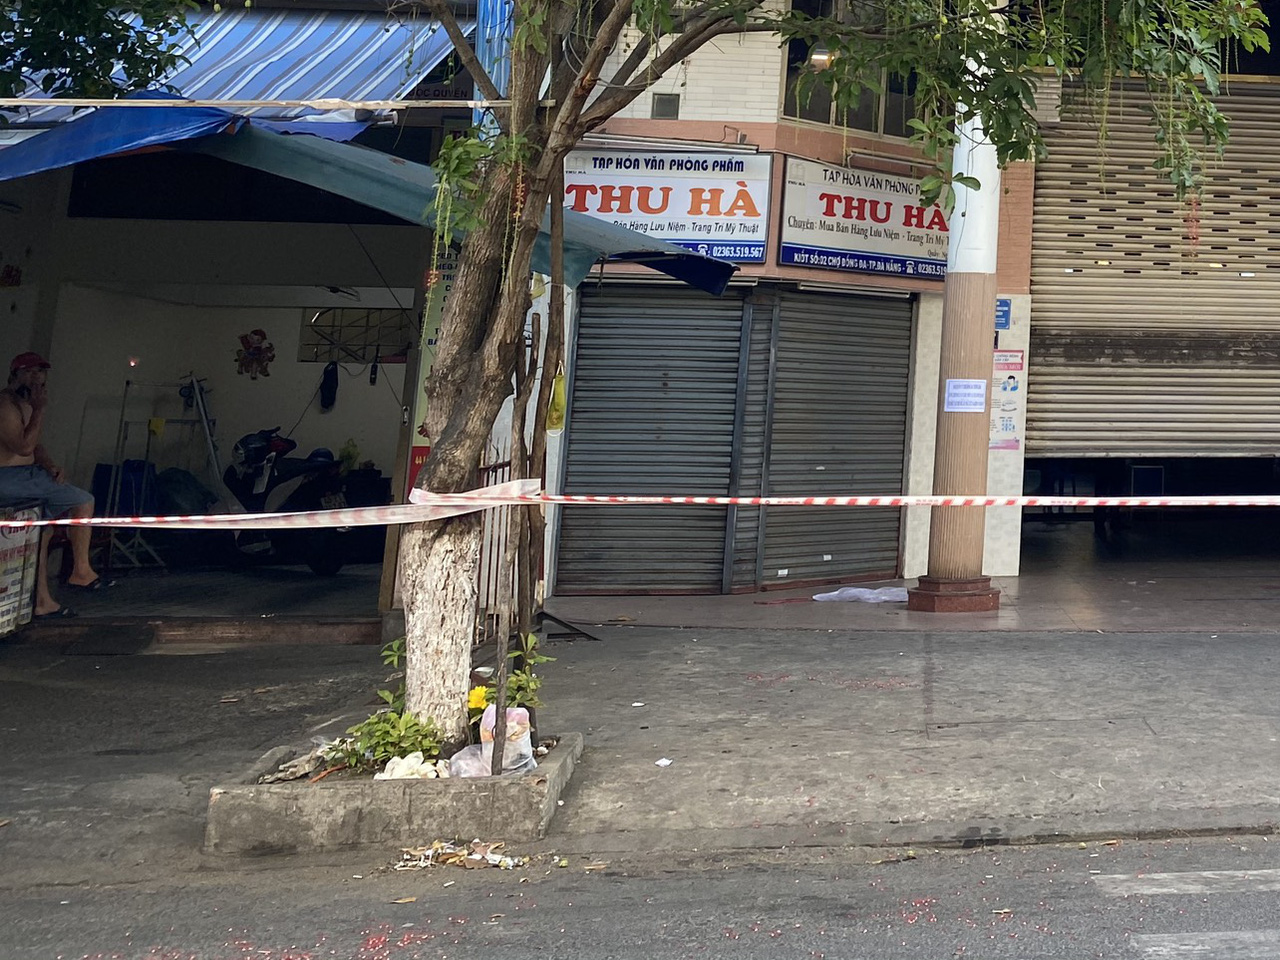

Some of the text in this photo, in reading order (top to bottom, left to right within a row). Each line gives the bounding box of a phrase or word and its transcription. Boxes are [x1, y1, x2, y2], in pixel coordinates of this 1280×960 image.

[592, 156, 613, 171] TẠP
[615, 154, 640, 170] HÓA
[644, 155, 665, 171] VĂN
[669, 158, 708, 172] PHÒNG
[823, 168, 841, 185] TẠP
[864, 173, 883, 190] VĂN
[565, 180, 761, 217] THU HÀ
[819, 192, 949, 232] THU HÀ
[629, 220, 648, 233] Hàng
[650, 221, 665, 231] Lưu
[667, 222, 686, 233] Niệm
[691, 222, 712, 234] Trang
[738, 223, 759, 234] Thuật
[819, 220, 835, 232] Mua
[851, 223, 868, 239] Hàng
[906, 231, 924, 246] Trang
[712, 245, 764, 258] 02363.519.567
